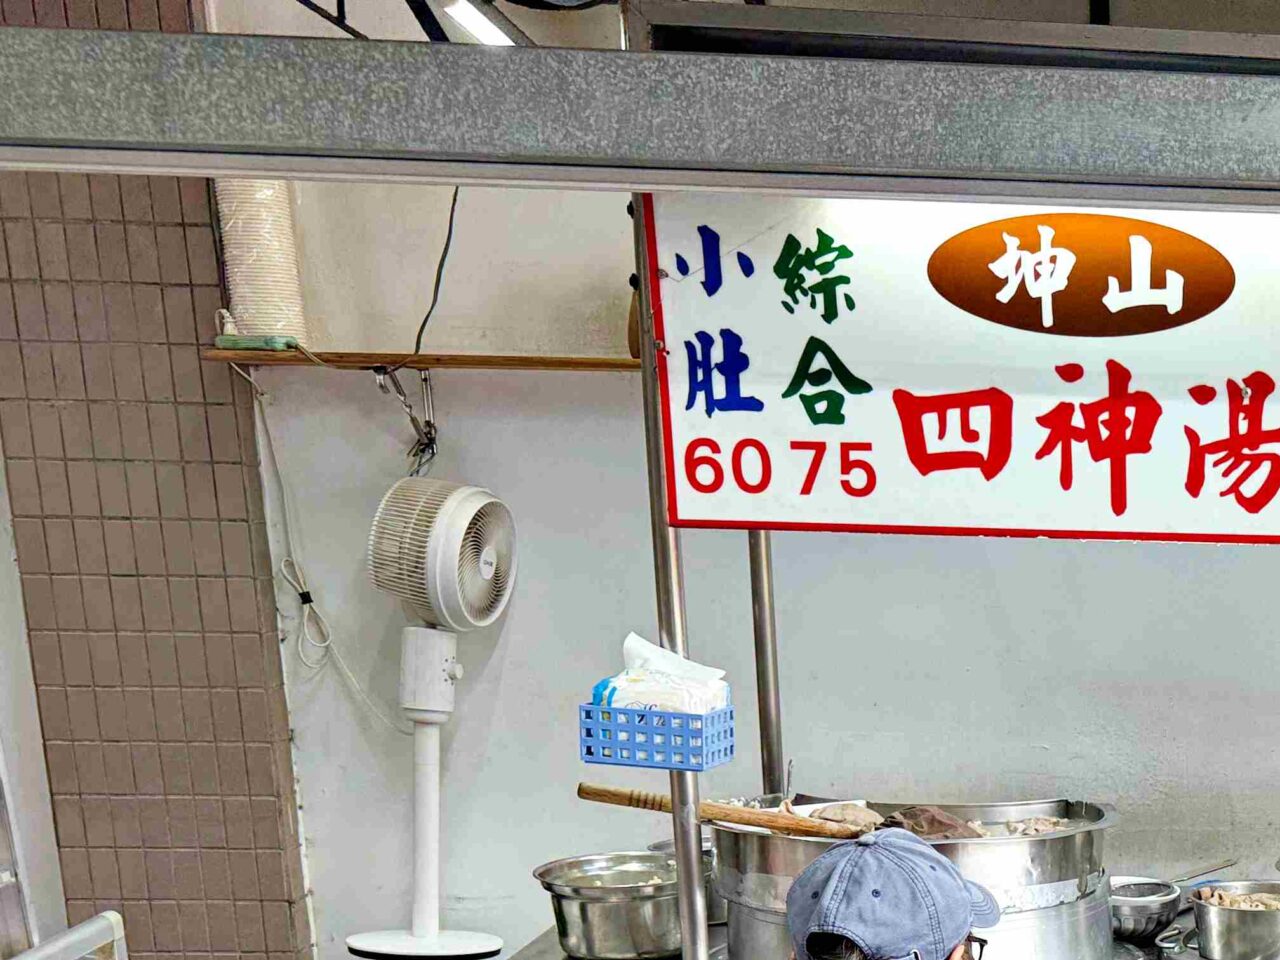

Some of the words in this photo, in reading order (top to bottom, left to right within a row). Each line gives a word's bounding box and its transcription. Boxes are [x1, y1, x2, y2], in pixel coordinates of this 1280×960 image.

[675, 225, 764, 418] 小肚
[773, 228, 873, 425] 綜合
[988, 225, 1184, 328] 坤山
[684, 437, 772, 494] 60
[790, 440, 877, 497] 75
